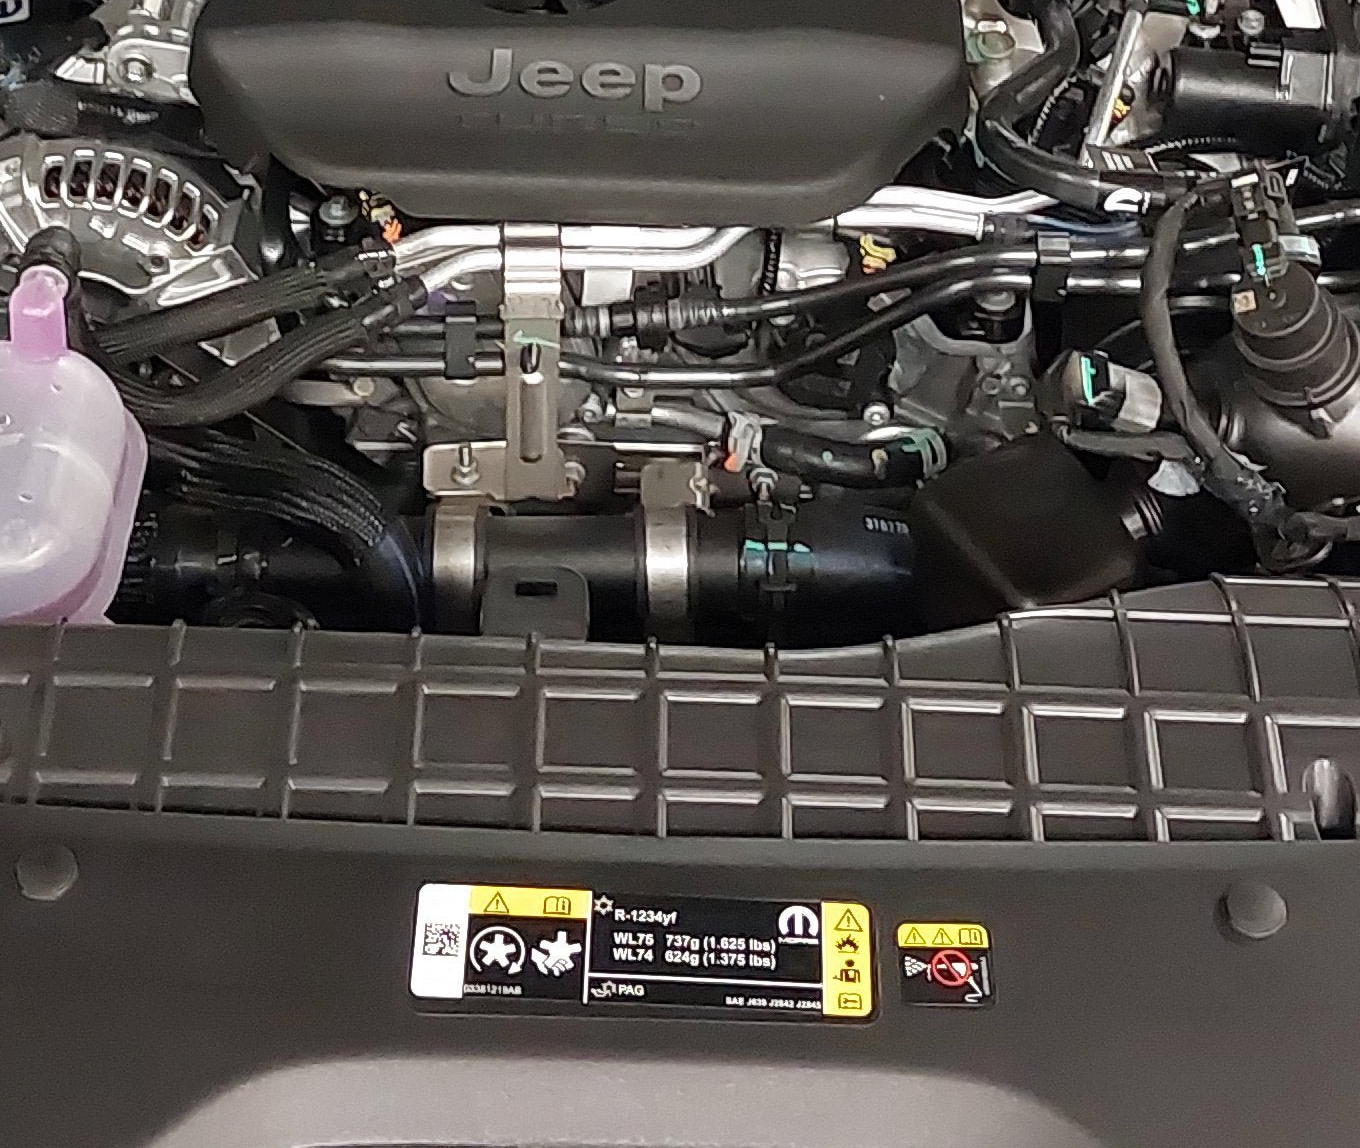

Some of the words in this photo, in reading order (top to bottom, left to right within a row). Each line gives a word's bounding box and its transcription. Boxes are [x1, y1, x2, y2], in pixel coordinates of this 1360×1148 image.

[447, 47, 700, 112] Jeep
[614, 908, 677, 926] R-1234yf
[665, 934, 700, 951] 737g
[703, 935, 746, 951] (1.625
[749, 938, 776, 955] lbs)
[612, 947, 654, 962] WL74
[664, 950, 700, 967] 624g
[702, 952, 746, 967] (1.375
[749, 953, 776, 970] lbs)
[618, 983, 645, 996] PAG
